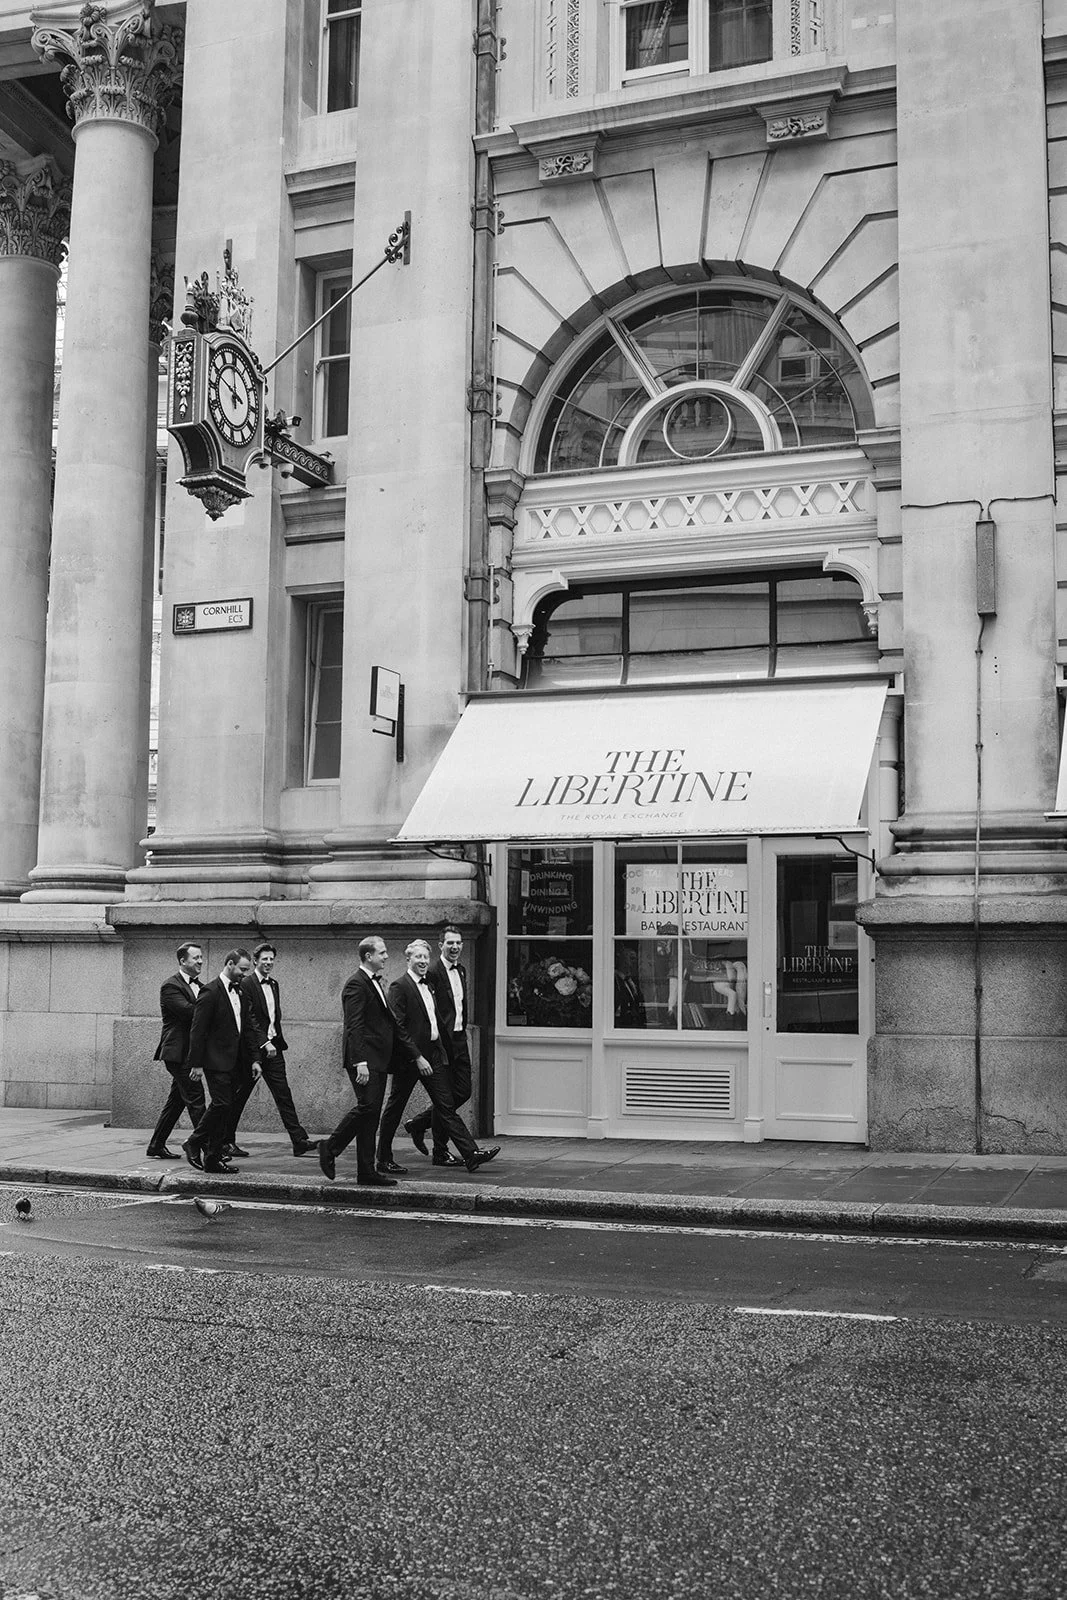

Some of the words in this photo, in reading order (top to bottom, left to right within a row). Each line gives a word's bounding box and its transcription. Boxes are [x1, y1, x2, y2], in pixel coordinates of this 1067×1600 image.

[203, 605, 243, 615] CORNHILL
[228, 615, 243, 623] EC3
[605, 749, 685, 773] THE
[515, 771, 752, 807] LIBERTINE
[622, 811, 685, 819] EXCHANGE
[530, 871, 573, 881] DRINKING
[676, 871, 717, 890] THE
[530, 888, 561, 896] DINING
[524, 901, 578, 914] UNWINDING
[641, 890, 748, 916] LIBERTINE
[804, 945, 830, 957] THE
[783, 957, 852, 974] LIBERTINE
